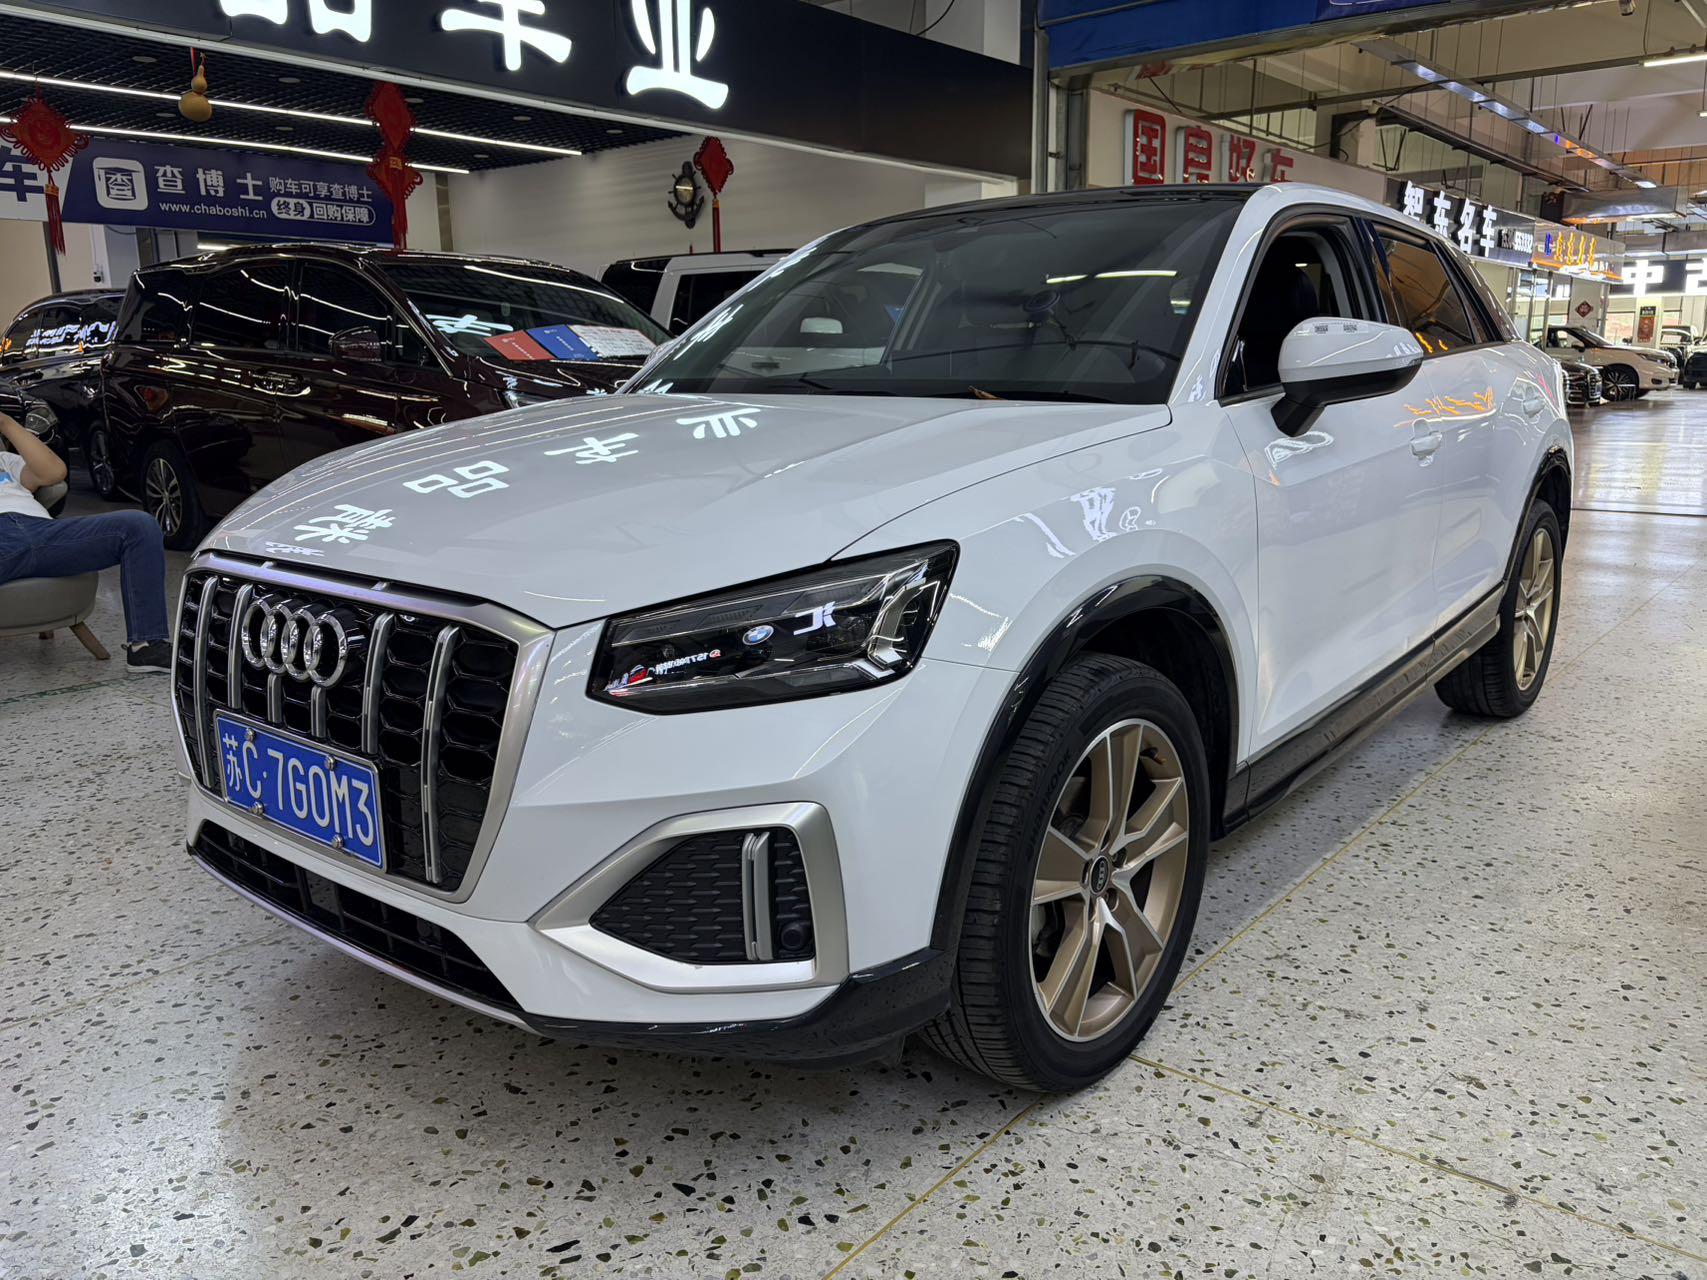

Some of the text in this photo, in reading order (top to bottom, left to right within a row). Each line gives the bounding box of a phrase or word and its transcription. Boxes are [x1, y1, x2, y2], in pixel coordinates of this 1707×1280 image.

[154, 164, 264, 201] 查博士
[268, 176, 373, 202] 购车可享查博士
[159, 201, 267, 219] www.chaboshi.cn
